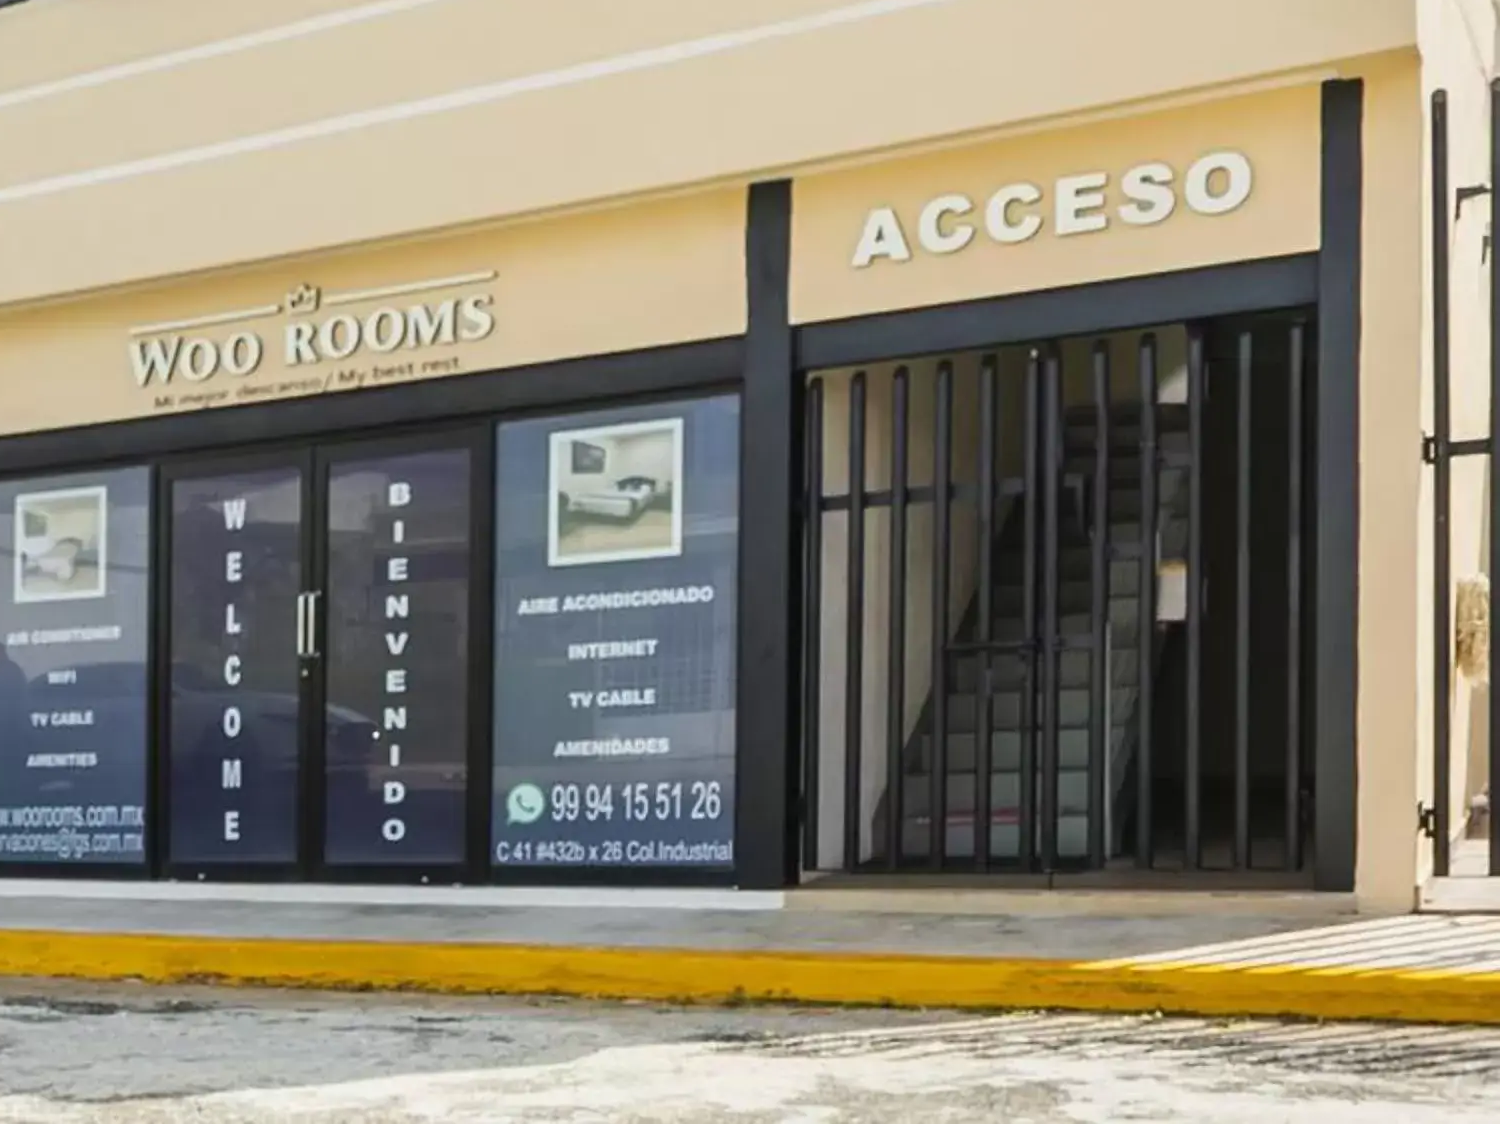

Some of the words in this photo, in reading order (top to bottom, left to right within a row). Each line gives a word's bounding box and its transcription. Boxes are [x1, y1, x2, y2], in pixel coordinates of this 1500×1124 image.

[850, 151, 1254, 268] ACCESO
[129, 331, 262, 387] WOO
[284, 293, 496, 366] ROOMS
[337, 368, 367, 388] My
[371, 361, 415, 379] best
[421, 356, 461, 374] rest
[517, 598, 560, 616] AIRE
[562, 586, 714, 613] ACONDICIONADO
[382, 481, 412, 842] BIENVENIDO
[568, 639, 658, 660] INTERNET
[222, 498, 247, 841] WELCOME
[568, 693, 593, 708] TV
[597, 689, 656, 707] CABLE
[30, 713, 49, 727] TV
[51, 710, 94, 726] CABLE
[553, 738, 670, 757] AMENIDADES
[550, 783, 580, 821] 99
[584, 783, 614, 821] 94
[621, 782, 650, 821] 15
[654, 781, 683, 820] 51
[690, 780, 722, 820] 26
[496, 841, 509, 862] C
[513, 841, 532, 861] 41
[588, 847, 599, 861] x
[601, 841, 622, 861] 26
